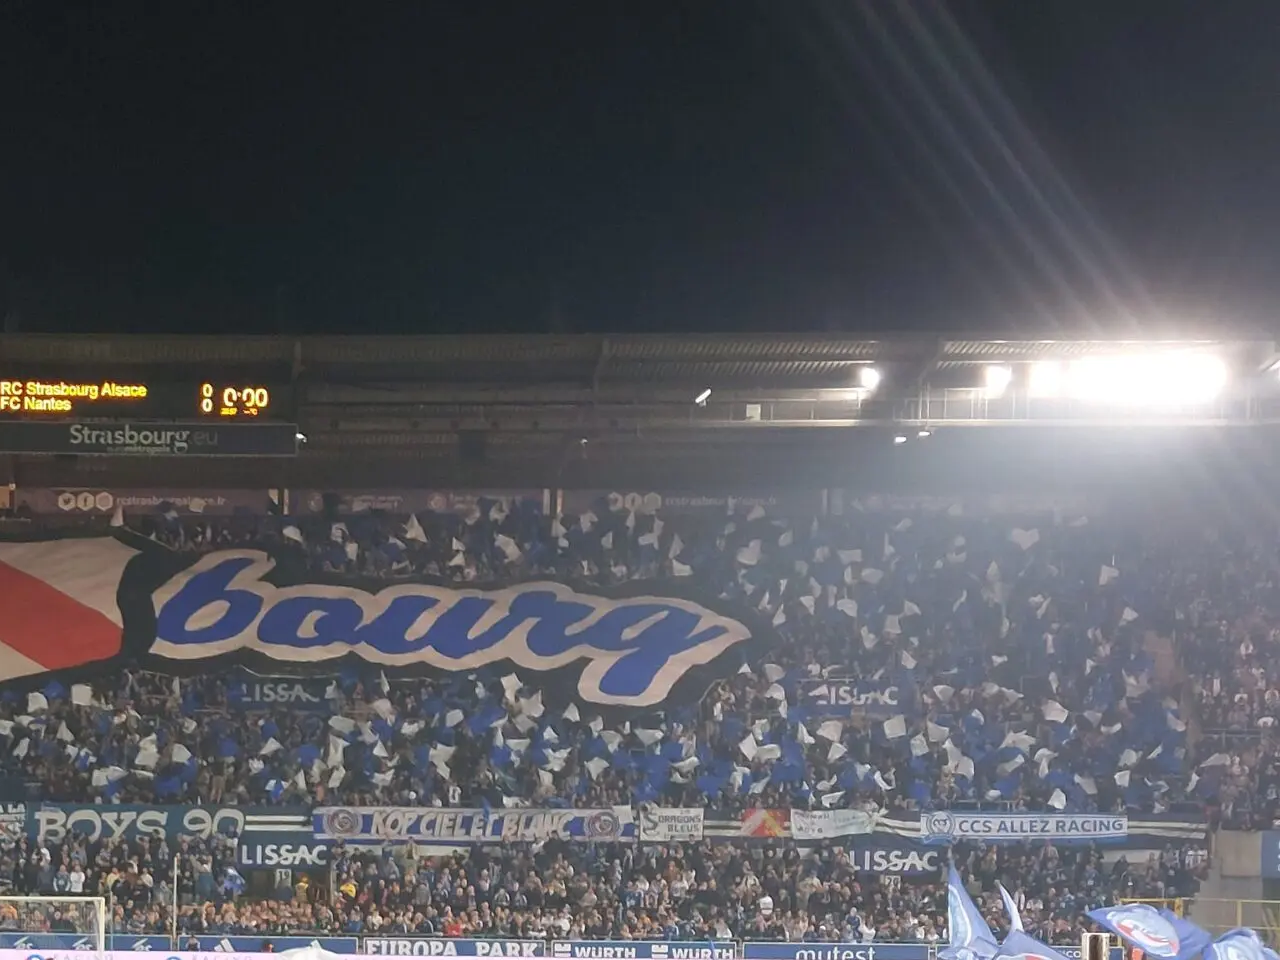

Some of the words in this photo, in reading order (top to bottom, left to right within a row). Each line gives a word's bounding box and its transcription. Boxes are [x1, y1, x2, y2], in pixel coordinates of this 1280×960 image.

[0, 381, 23, 395] RC
[25, 381, 99, 400] Strasbourg
[101, 382, 147, 397] Alsace
[202, 383, 213, 398] 0
[0, 396, 21, 410] FC
[24, 396, 72, 411] Nantes
[202, 398, 213, 412] 0
[148, 549, 753, 707] bourg
[34, 809, 168, 844] BOYS
[183, 808, 244, 842] 90
[370, 810, 419, 837] KOP
[420, 811, 466, 838] CIEL
[470, 812, 500, 838] ET
[501, 812, 576, 841] BLANC
[658, 815, 701, 824] DRAGONS
[958, 819, 993, 834] CCS
[996, 819, 1050, 834] ALLEZ
[1056, 819, 1124, 833] RACING
[667, 824, 699, 832] BLEUS
[241, 844, 327, 865] LISSAC
[849, 851, 938, 871] LISSAC
[366, 940, 457, 956] EUROPA
[475, 942, 538, 957] PARK
[795, 946, 876, 960] mutest
